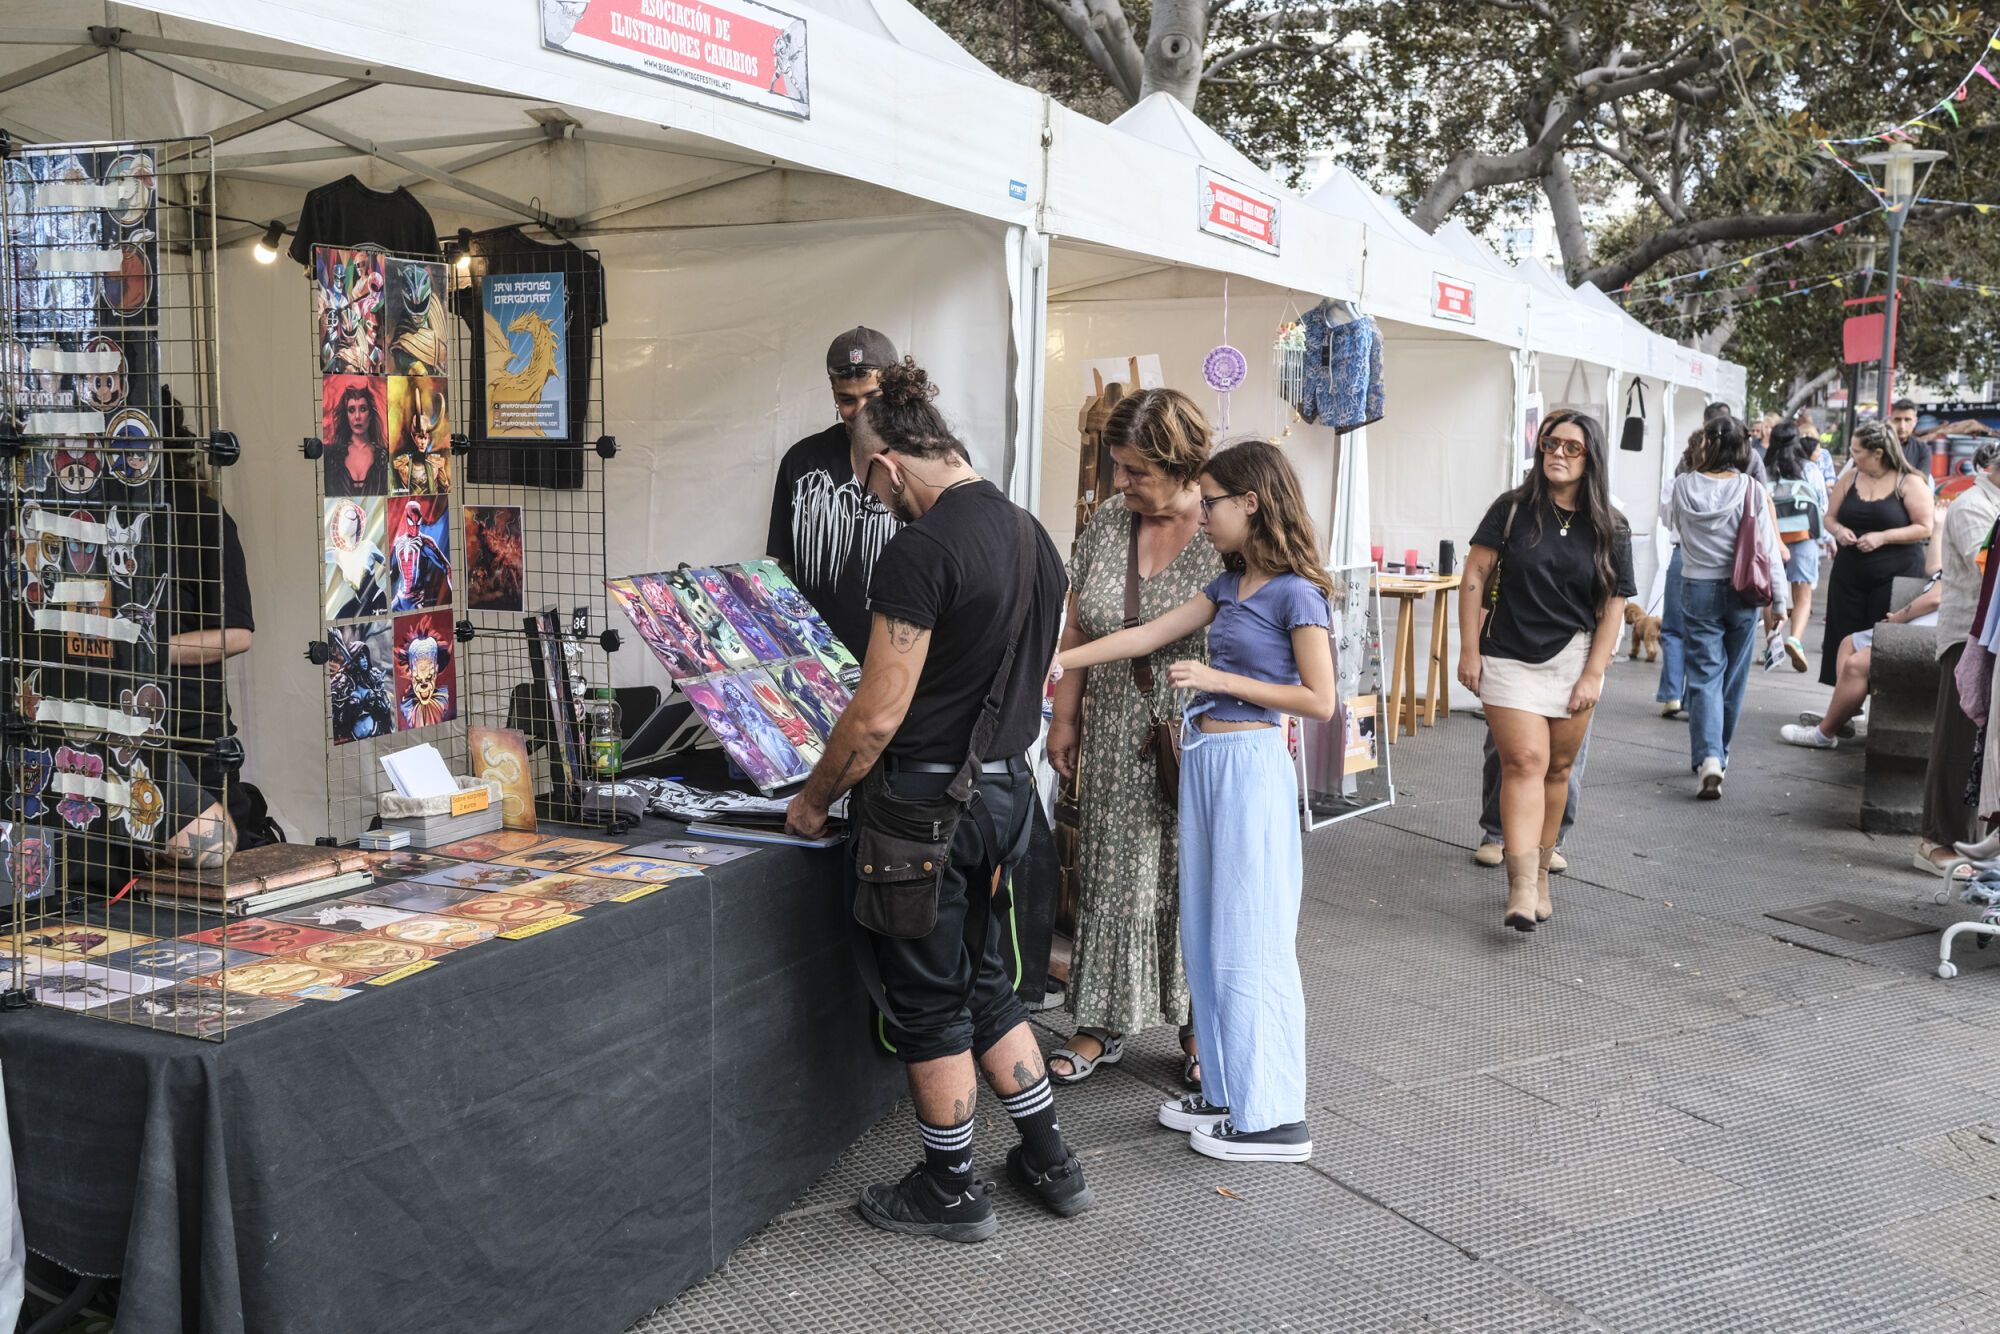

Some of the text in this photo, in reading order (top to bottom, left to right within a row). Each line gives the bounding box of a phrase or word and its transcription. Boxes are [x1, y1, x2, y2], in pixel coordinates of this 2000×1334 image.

[641, 0, 731, 42] ASOCIACIÓN DE
[610, 11, 758, 77] ILUSTRADORES CANARIOS
[494, 282, 512, 293] JAVI
[494, 293, 551, 304] DRAGONART
[72, 638, 110, 655] GIANT
